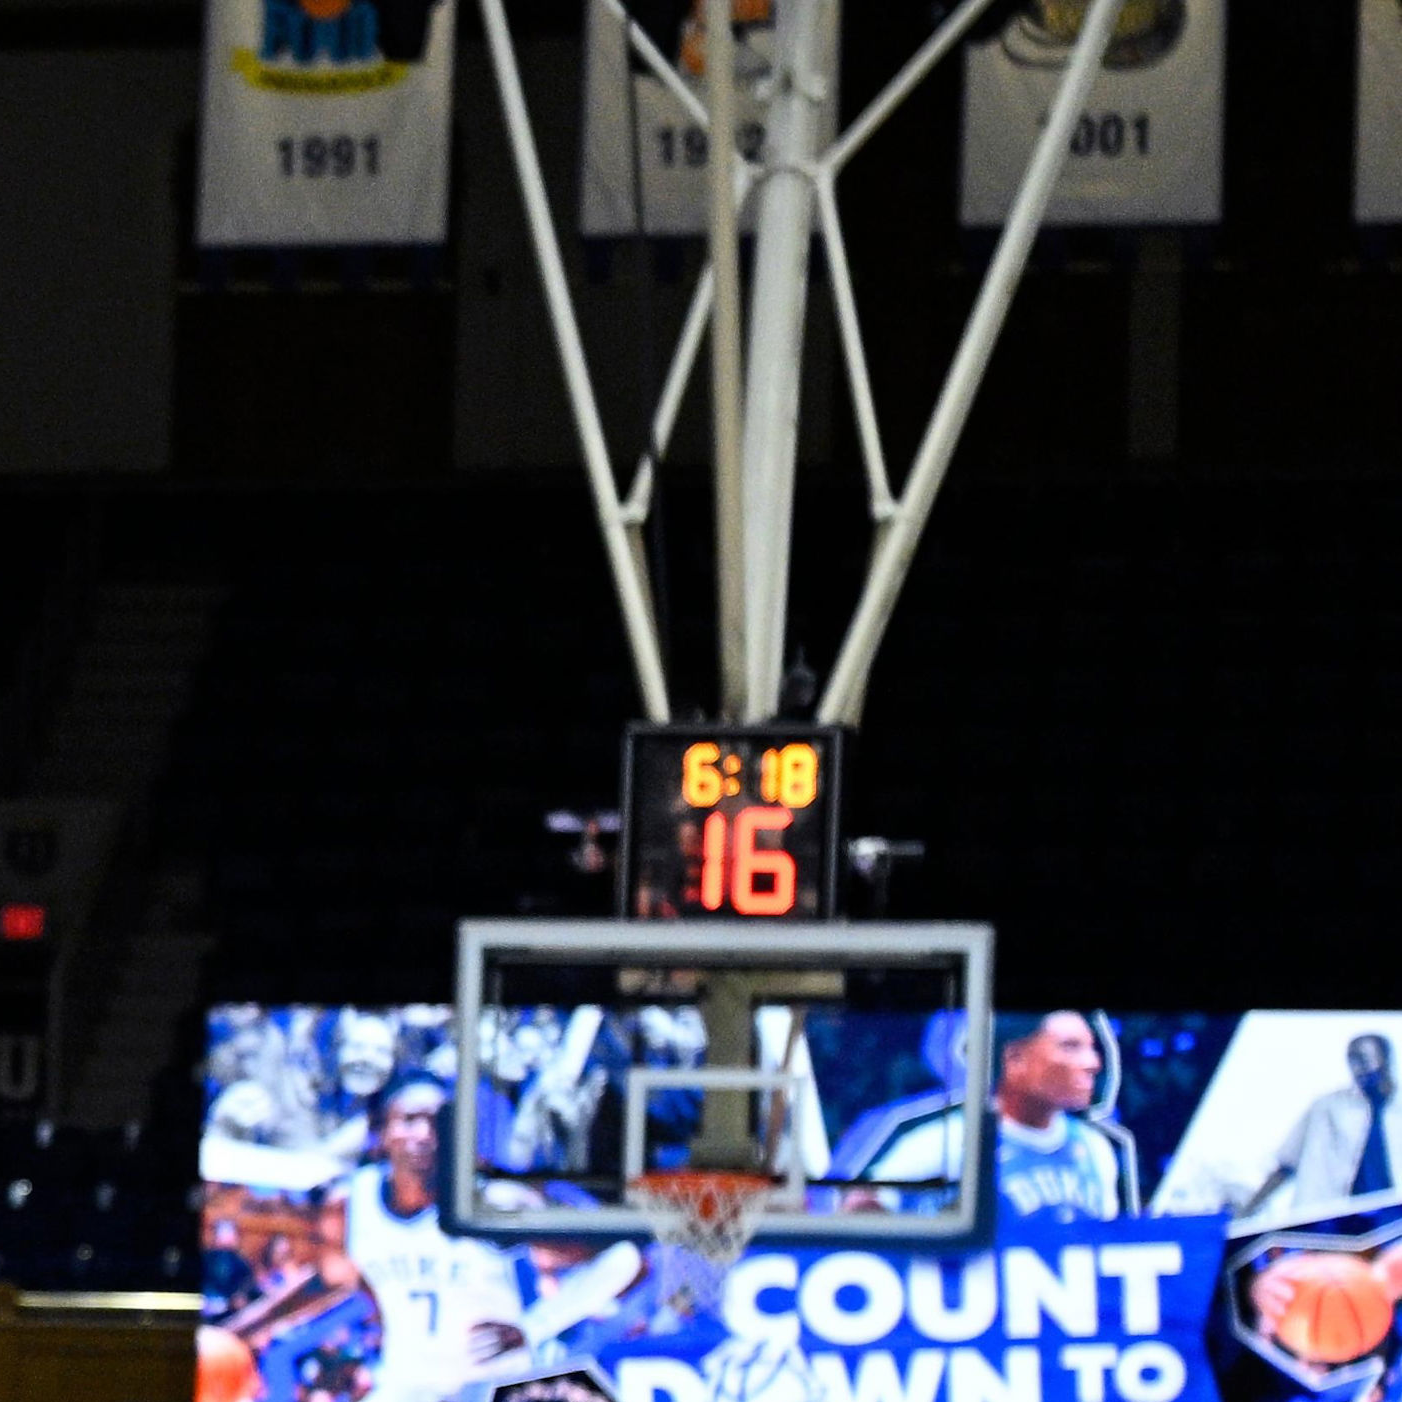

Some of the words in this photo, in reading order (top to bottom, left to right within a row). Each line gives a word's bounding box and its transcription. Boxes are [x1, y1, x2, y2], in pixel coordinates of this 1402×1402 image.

[276, 135, 382, 178] 1991
[658, 122, 766, 168] 192
[682, 742, 819, 808] 6:18
[701, 806, 796, 916] 16
[722, 1242, 1183, 1346] COUNT
